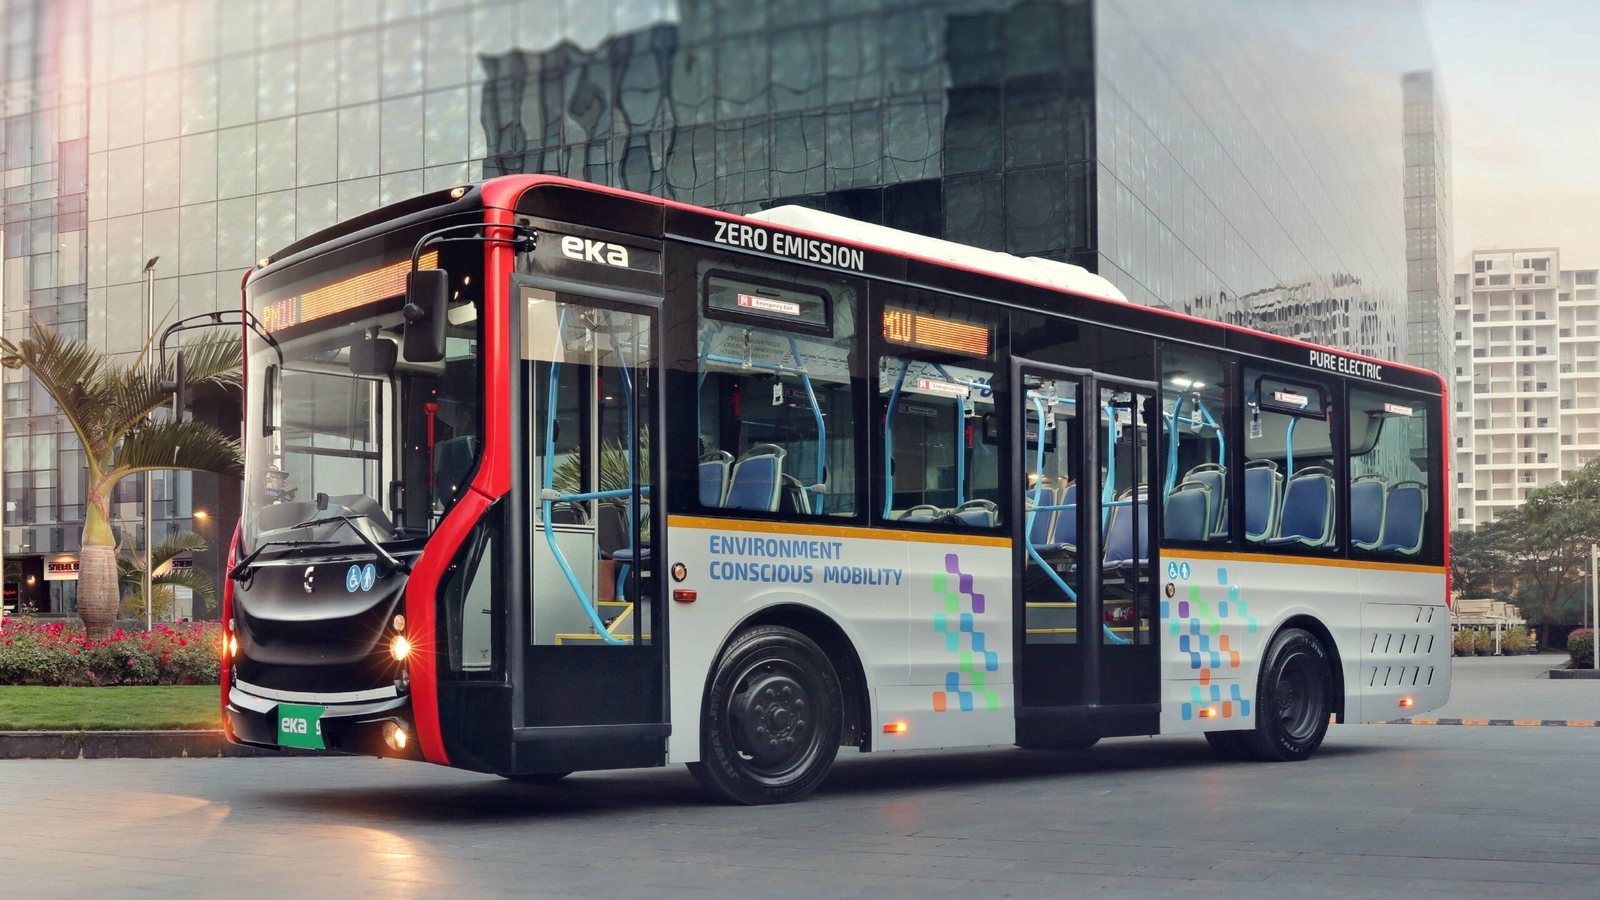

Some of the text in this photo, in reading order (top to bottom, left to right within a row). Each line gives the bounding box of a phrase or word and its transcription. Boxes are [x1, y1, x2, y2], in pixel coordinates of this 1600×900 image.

[561, 235, 629, 268] eka
[714, 220, 864, 272] ZERO EMISSION
[1310, 350, 1382, 380] PURE ELECTRIC
[709, 535, 843, 560] ENVIRONMENT
[709, 561, 903, 586] CONSCIOUS MOBILITY
[281, 717, 307, 734] eka
